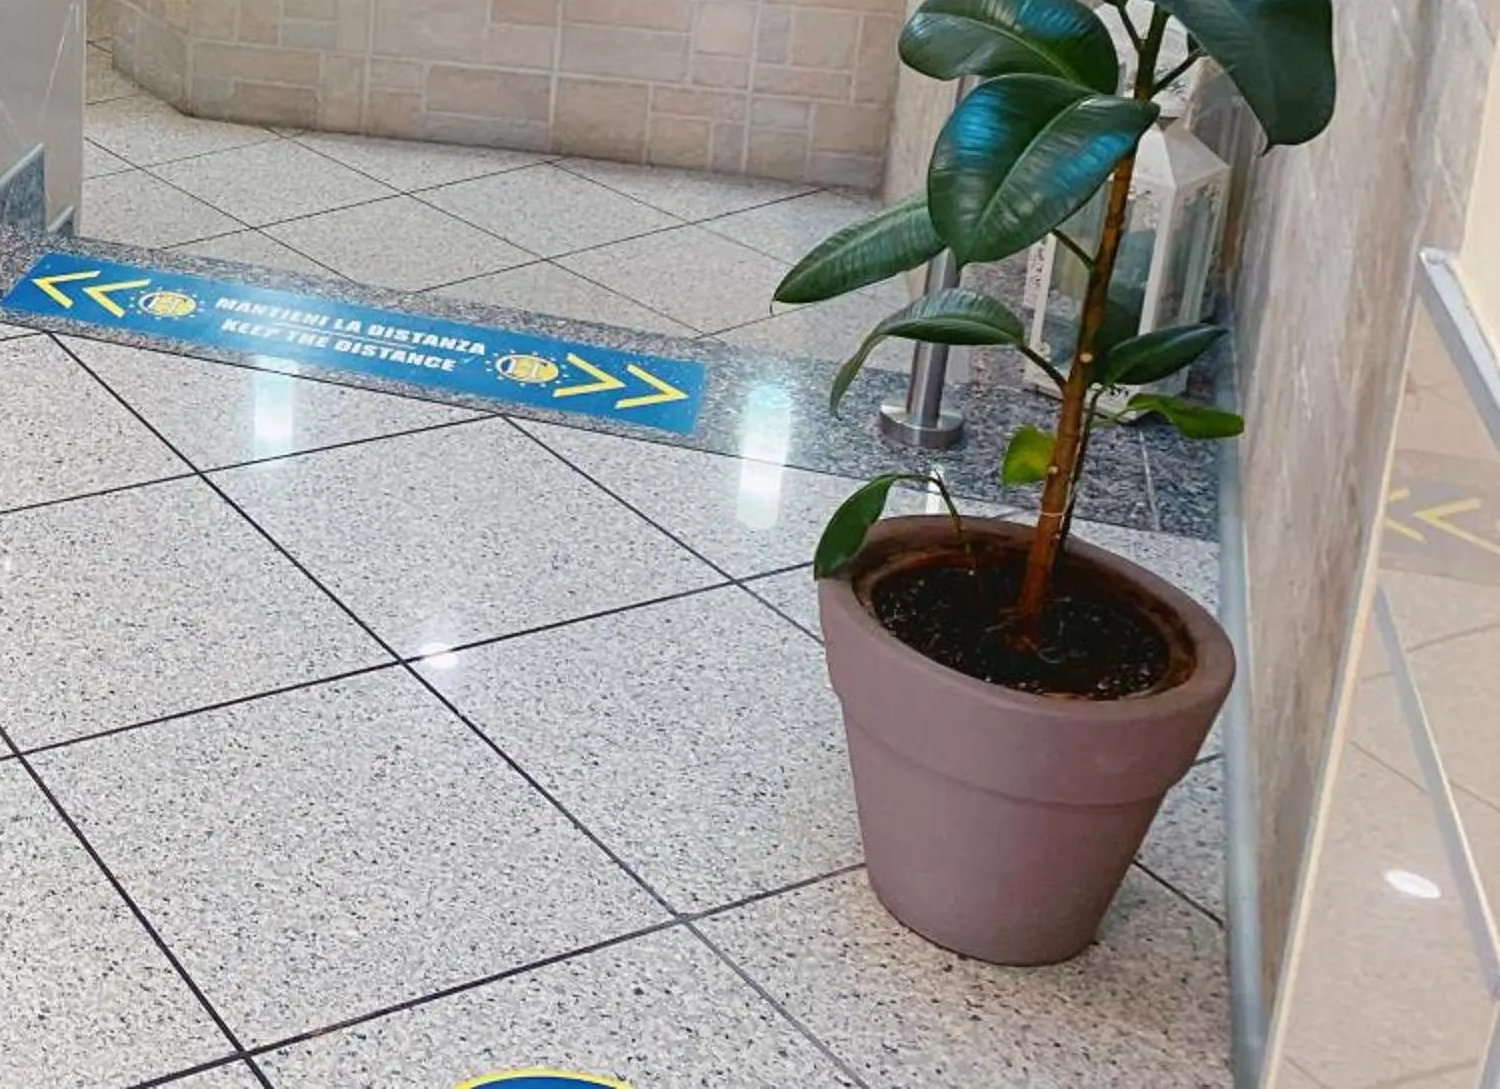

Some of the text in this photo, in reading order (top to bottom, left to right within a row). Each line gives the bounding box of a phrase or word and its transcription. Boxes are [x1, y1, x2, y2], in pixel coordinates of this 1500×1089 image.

[214, 297, 486, 355] MANTIENI LA DISTANZA
[220, 318, 457, 372] KEEP THE DISTANCE
